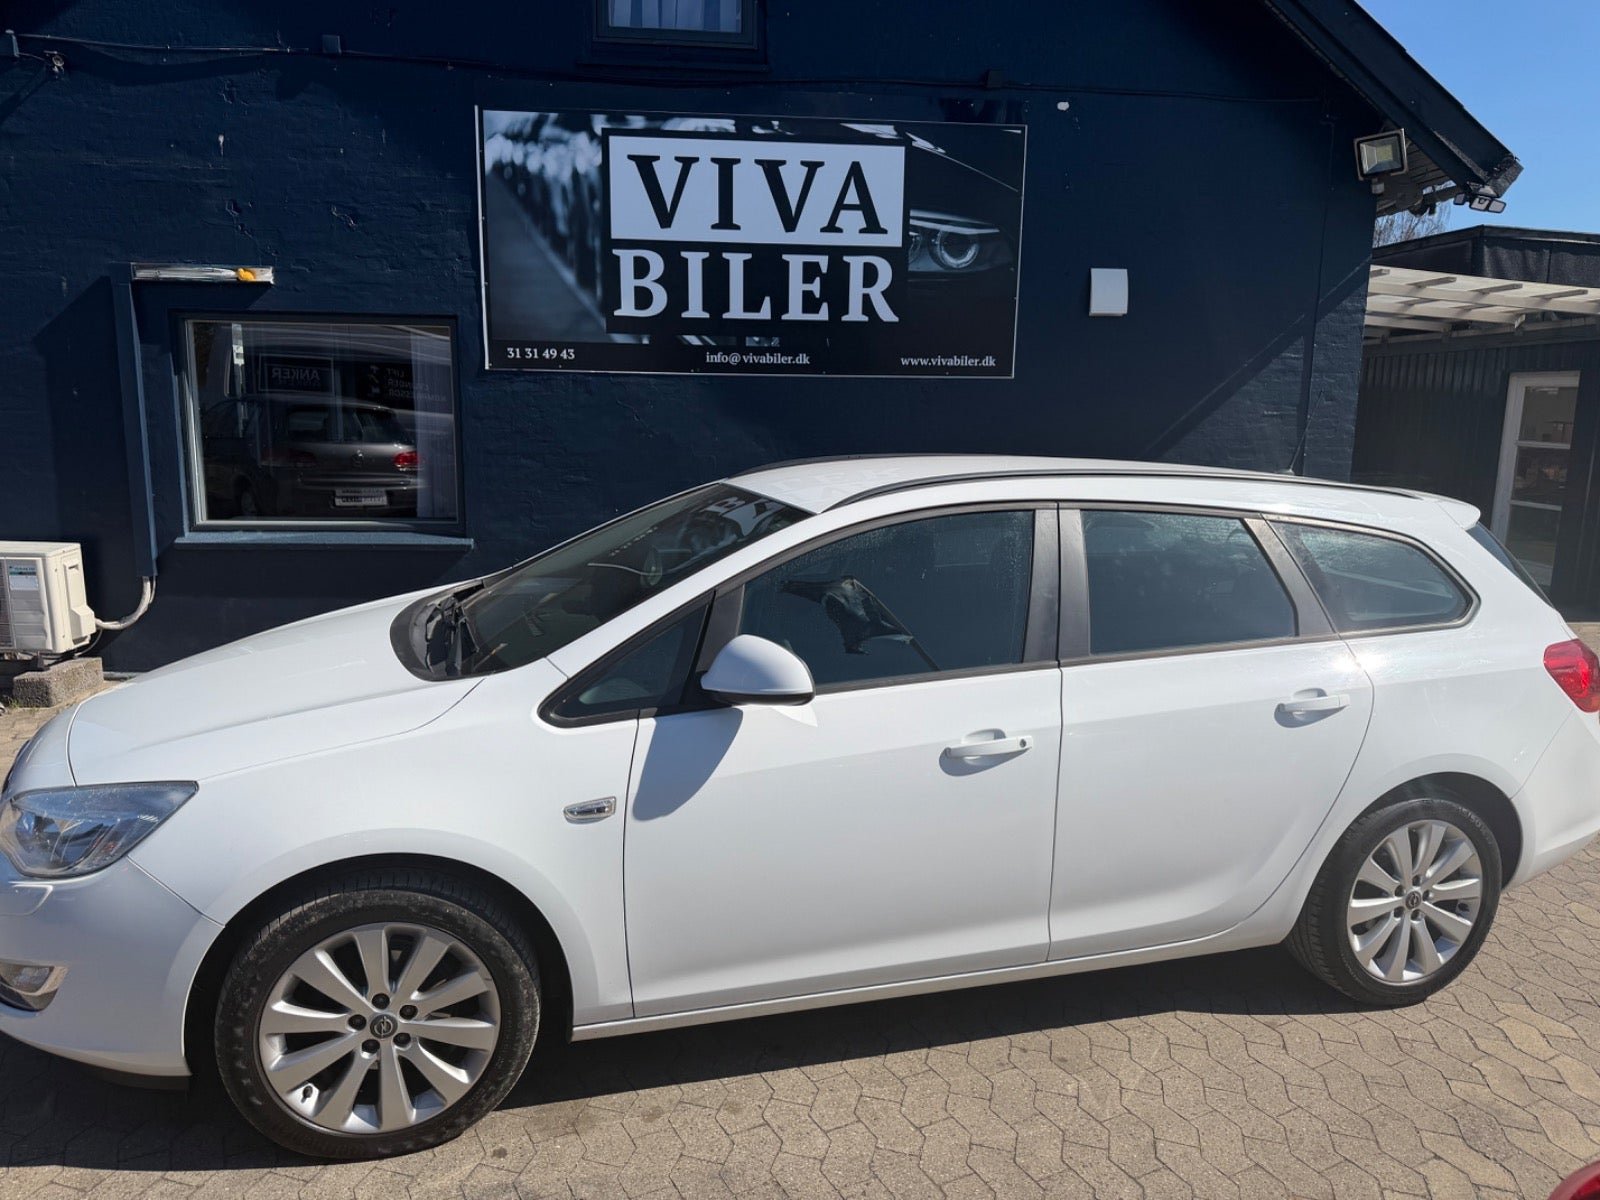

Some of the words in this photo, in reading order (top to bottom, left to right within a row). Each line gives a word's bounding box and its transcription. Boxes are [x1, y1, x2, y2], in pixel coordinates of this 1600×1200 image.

[627, 154, 888, 235] VIVA
[612, 248, 899, 322] BILER
[507, 347, 521, 359] 31
[524, 347, 539, 359] 31
[542, 348, 558, 360] 49
[560, 348, 576, 360] 43
[706, 351, 811, 366] info@vivabiler.dk
[900, 355, 996, 367] www.vivabiler.dk
